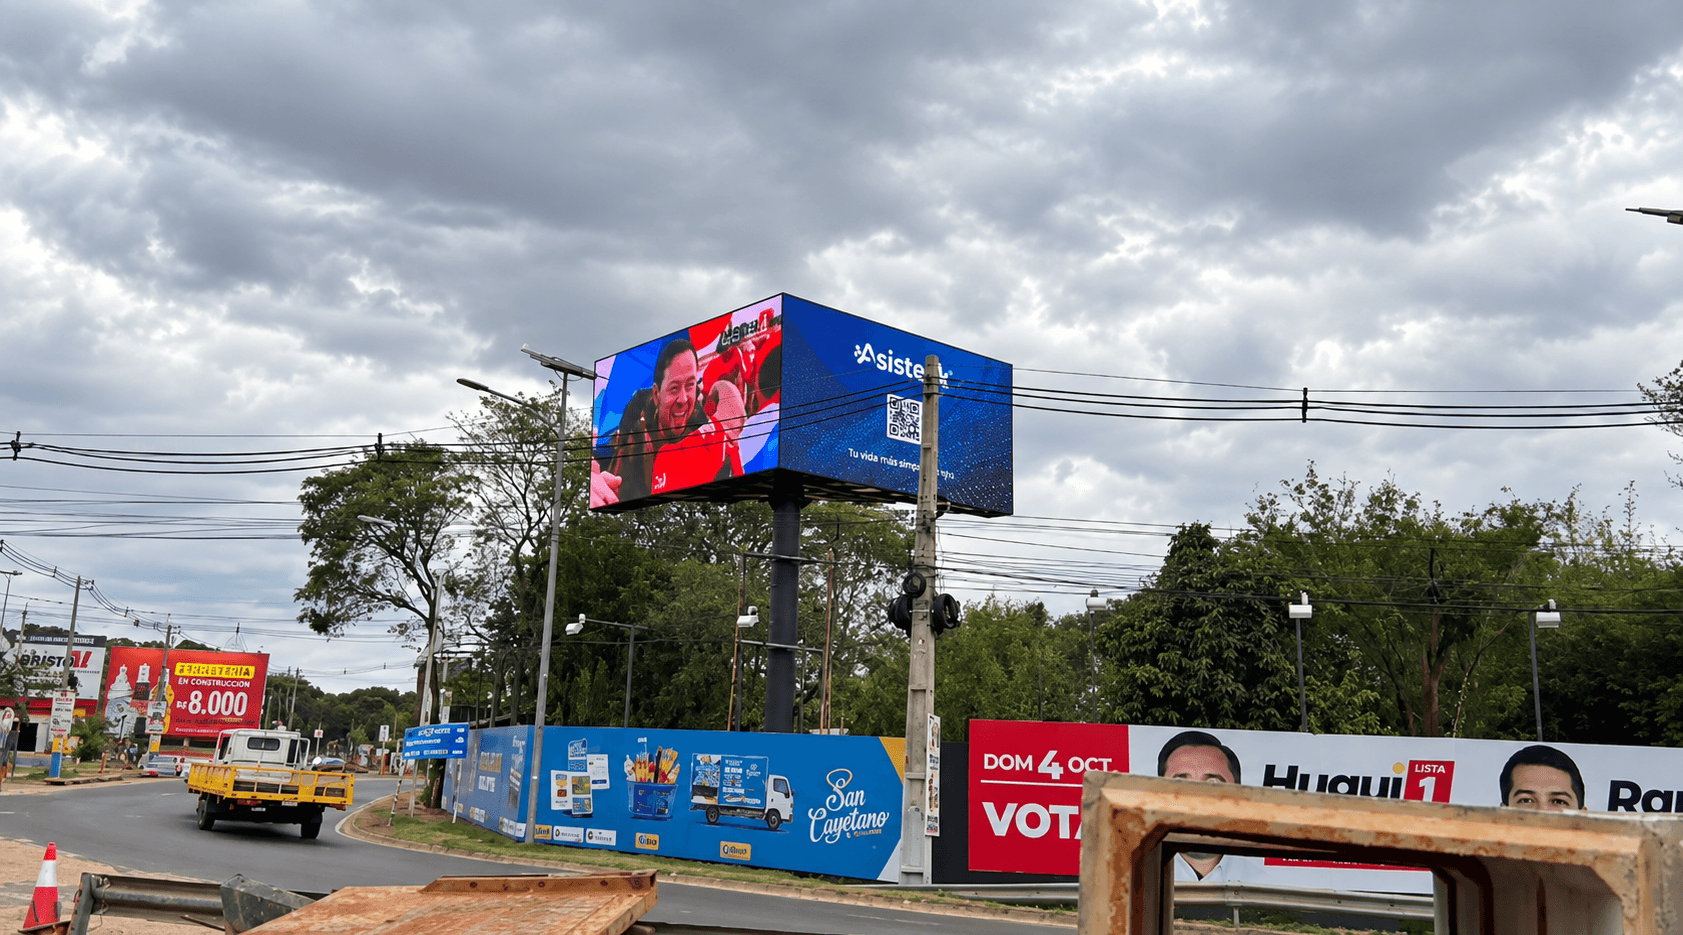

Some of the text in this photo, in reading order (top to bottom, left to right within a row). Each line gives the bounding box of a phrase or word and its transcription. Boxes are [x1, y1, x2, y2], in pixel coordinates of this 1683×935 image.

[848, 448, 859, 458] Tu
[860, 450, 878, 462] vida
[188, 690, 248, 717] 8.000
[984, 750, 1113, 780] DOM 4 OCT
[1414, 763, 1446, 774] LISTA
[826, 768, 866, 811] San
[1418, 776, 1436, 802] 1
[808, 807, 890, 844] Cayetano
[982, 802, 1082, 840] VOT
